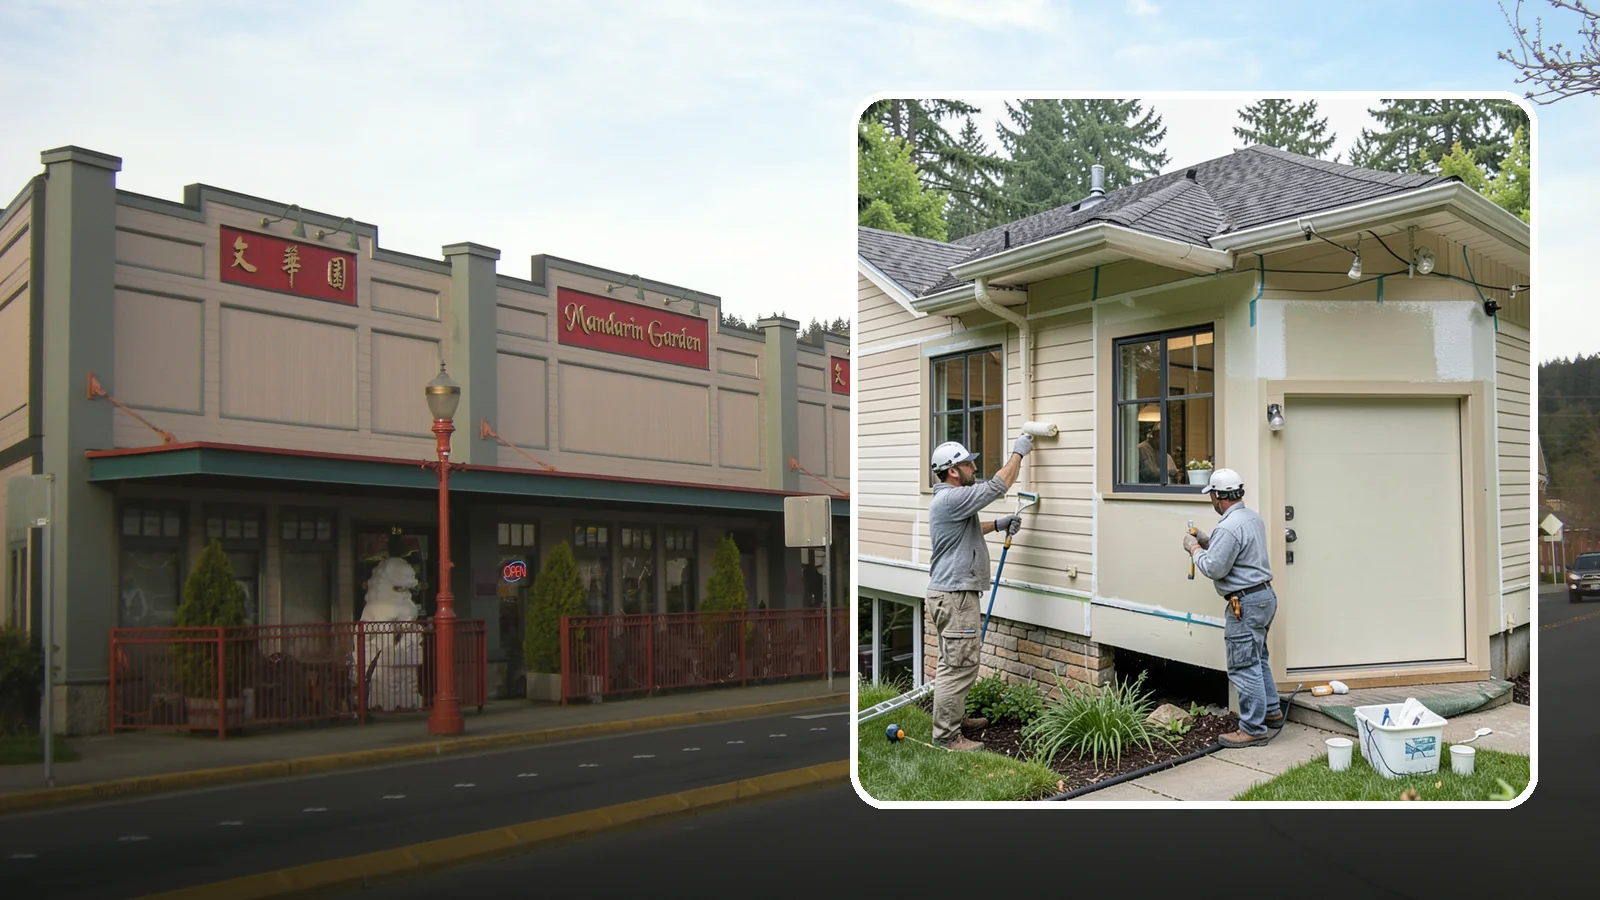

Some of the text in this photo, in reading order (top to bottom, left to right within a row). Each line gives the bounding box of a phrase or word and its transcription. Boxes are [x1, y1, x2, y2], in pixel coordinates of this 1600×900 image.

[231, 235, 346, 291] 文華園
[564, 302, 702, 352] Mandarin Garden
[503, 565, 527, 578] OPEN
